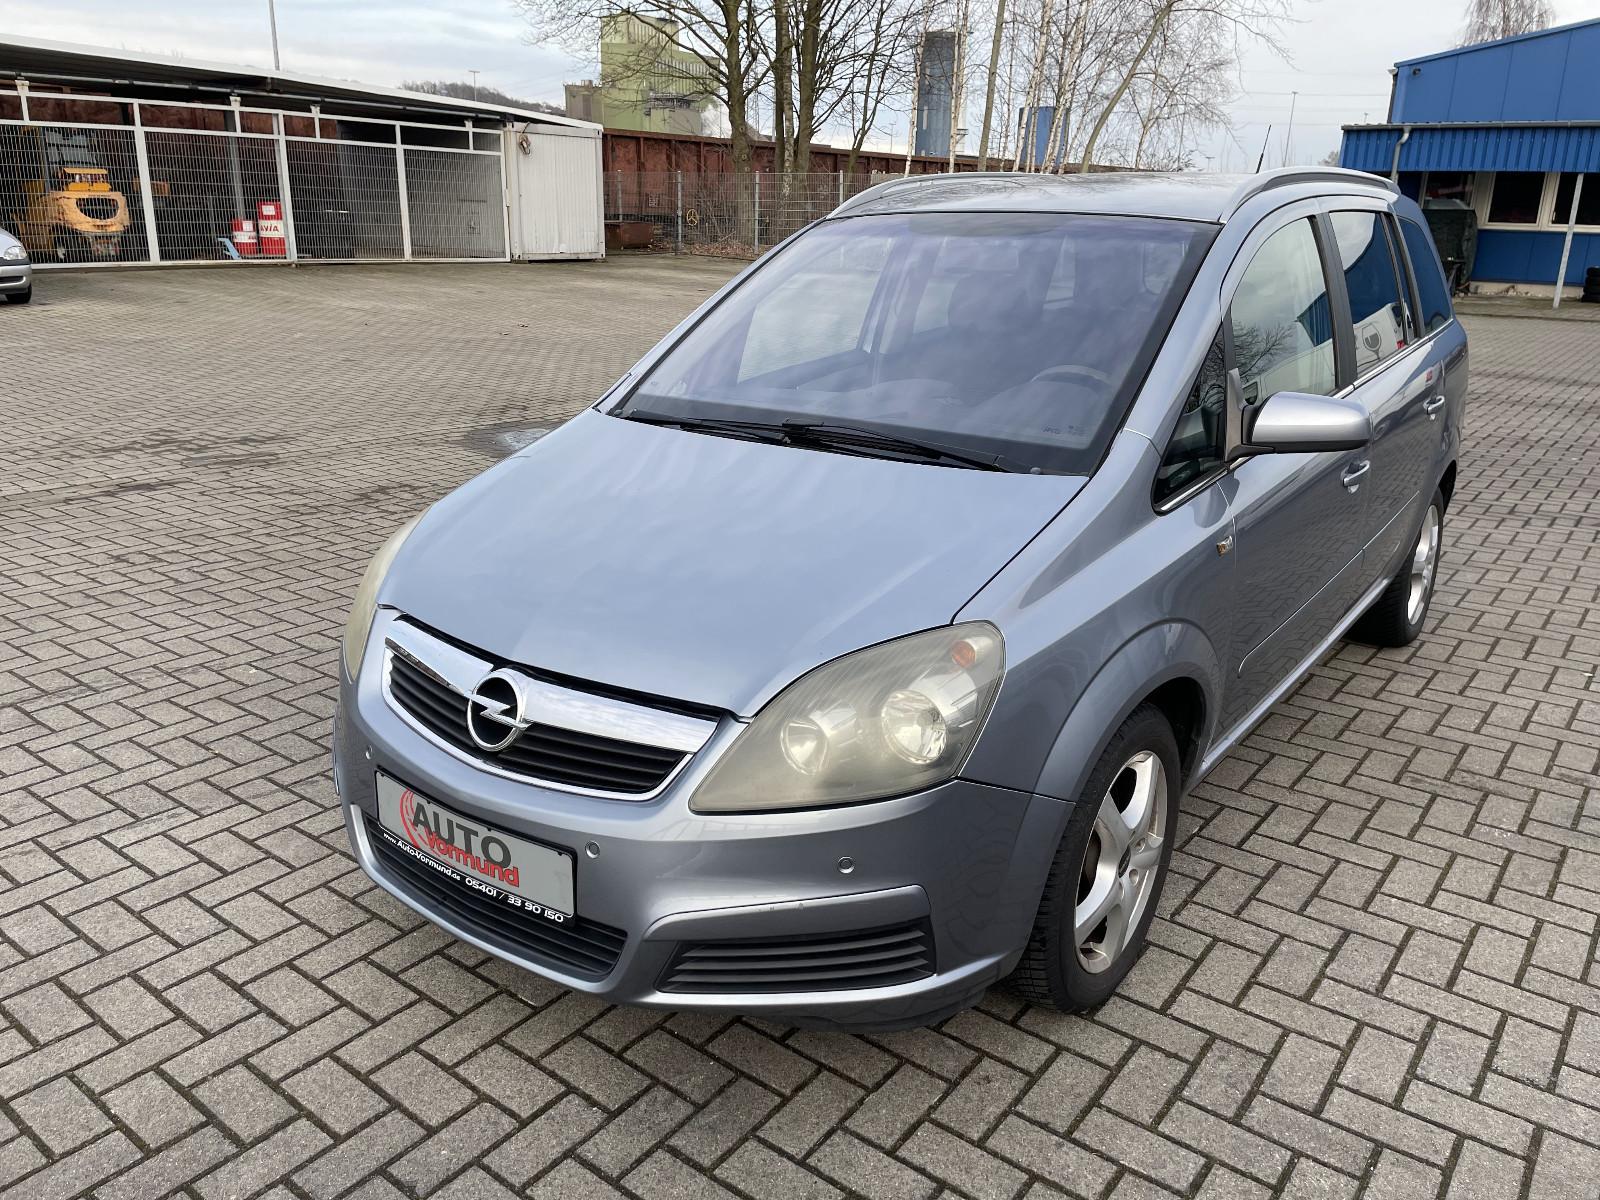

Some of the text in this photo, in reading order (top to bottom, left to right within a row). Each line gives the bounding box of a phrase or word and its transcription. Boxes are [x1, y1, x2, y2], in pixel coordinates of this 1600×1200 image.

[412, 802, 511, 869] AUTO
[425, 826, 520, 888] Vormund
[465, 877, 497, 897] 05401
[507, 894, 522, 907] 33
[524, 902, 541, 915] 90
[544, 909, 564, 923] 150
